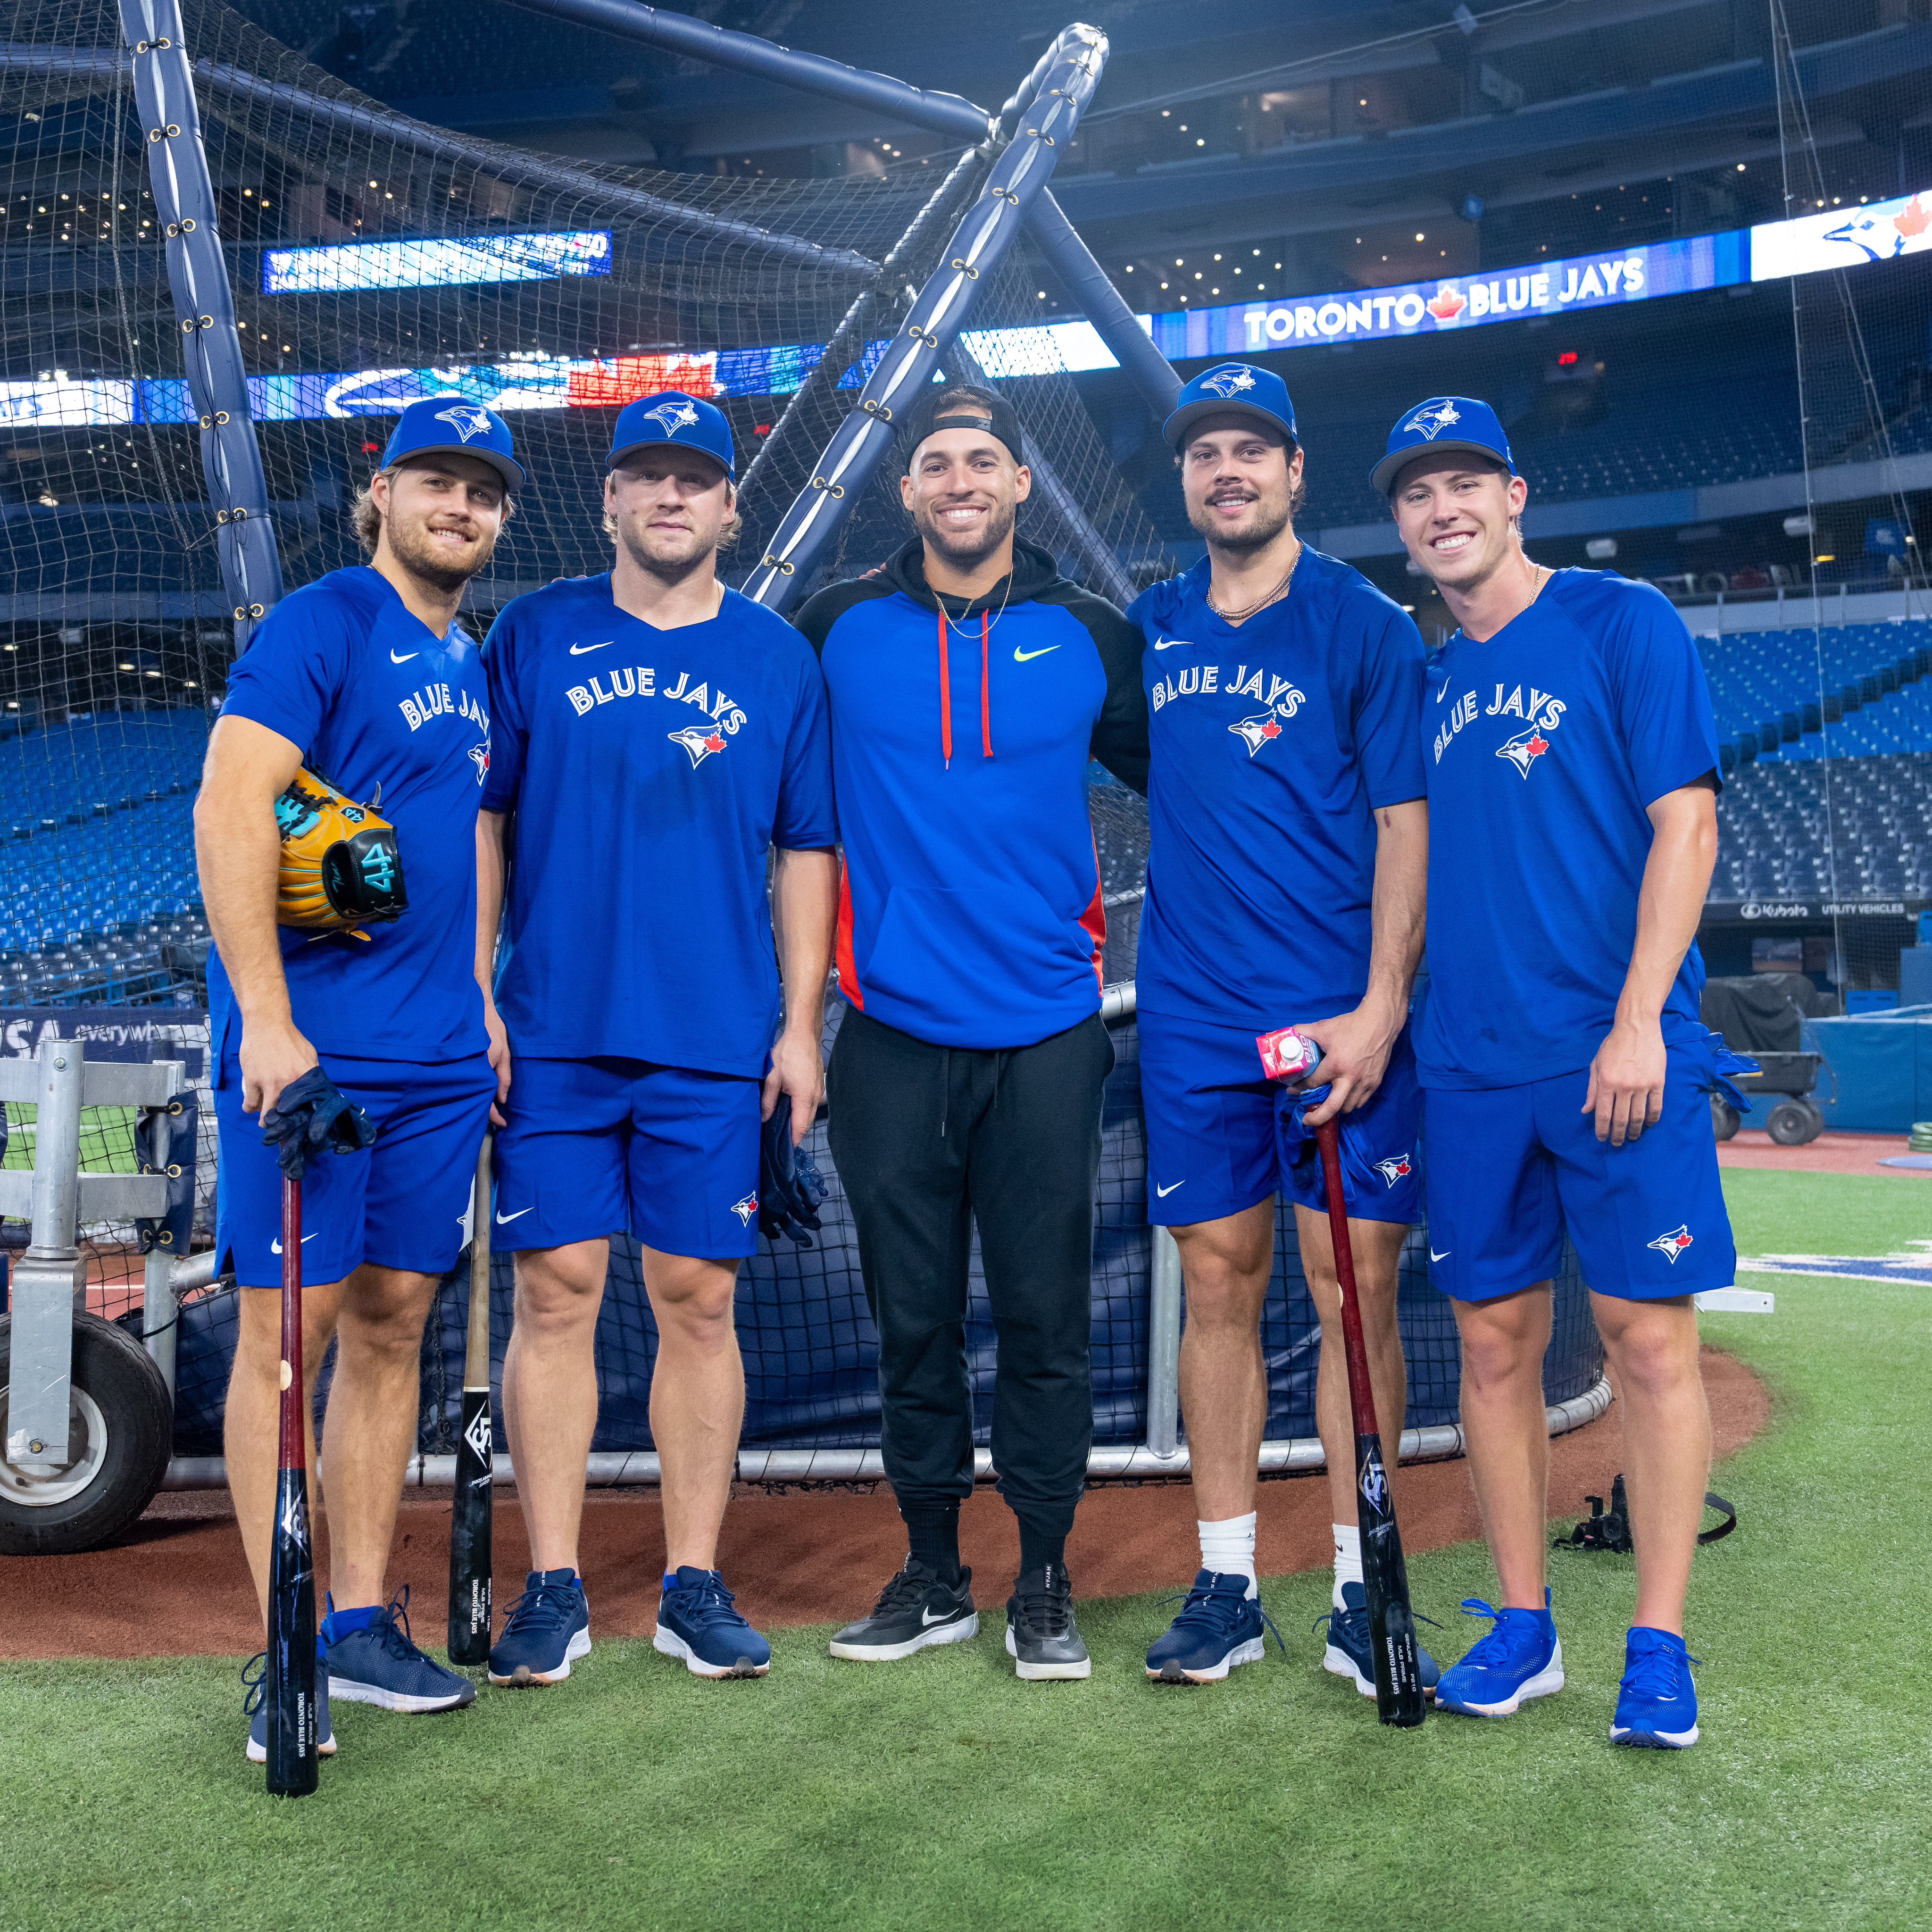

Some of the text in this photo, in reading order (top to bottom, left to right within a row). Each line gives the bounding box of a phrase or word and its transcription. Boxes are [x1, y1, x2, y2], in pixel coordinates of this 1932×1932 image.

[1244, 258, 1643, 343] TORONTO BLUE JAYS
[398, 683, 491, 739] BLUE JAY
[566, 666, 747, 735] BLUE JAYS
[1152, 665, 1307, 718] BLUE JAYS
[1433, 683, 1567, 766] BLUE JAYS
[361, 842, 395, 893] 44
[1763, 903, 1904, 917] Kubota UTILITY VEHICLES
[1386, 1636, 1396, 1666] TORONTO
[1391, 1682, 1399, 1695] JAYS
[297, 1743, 305, 1758] JAYS
